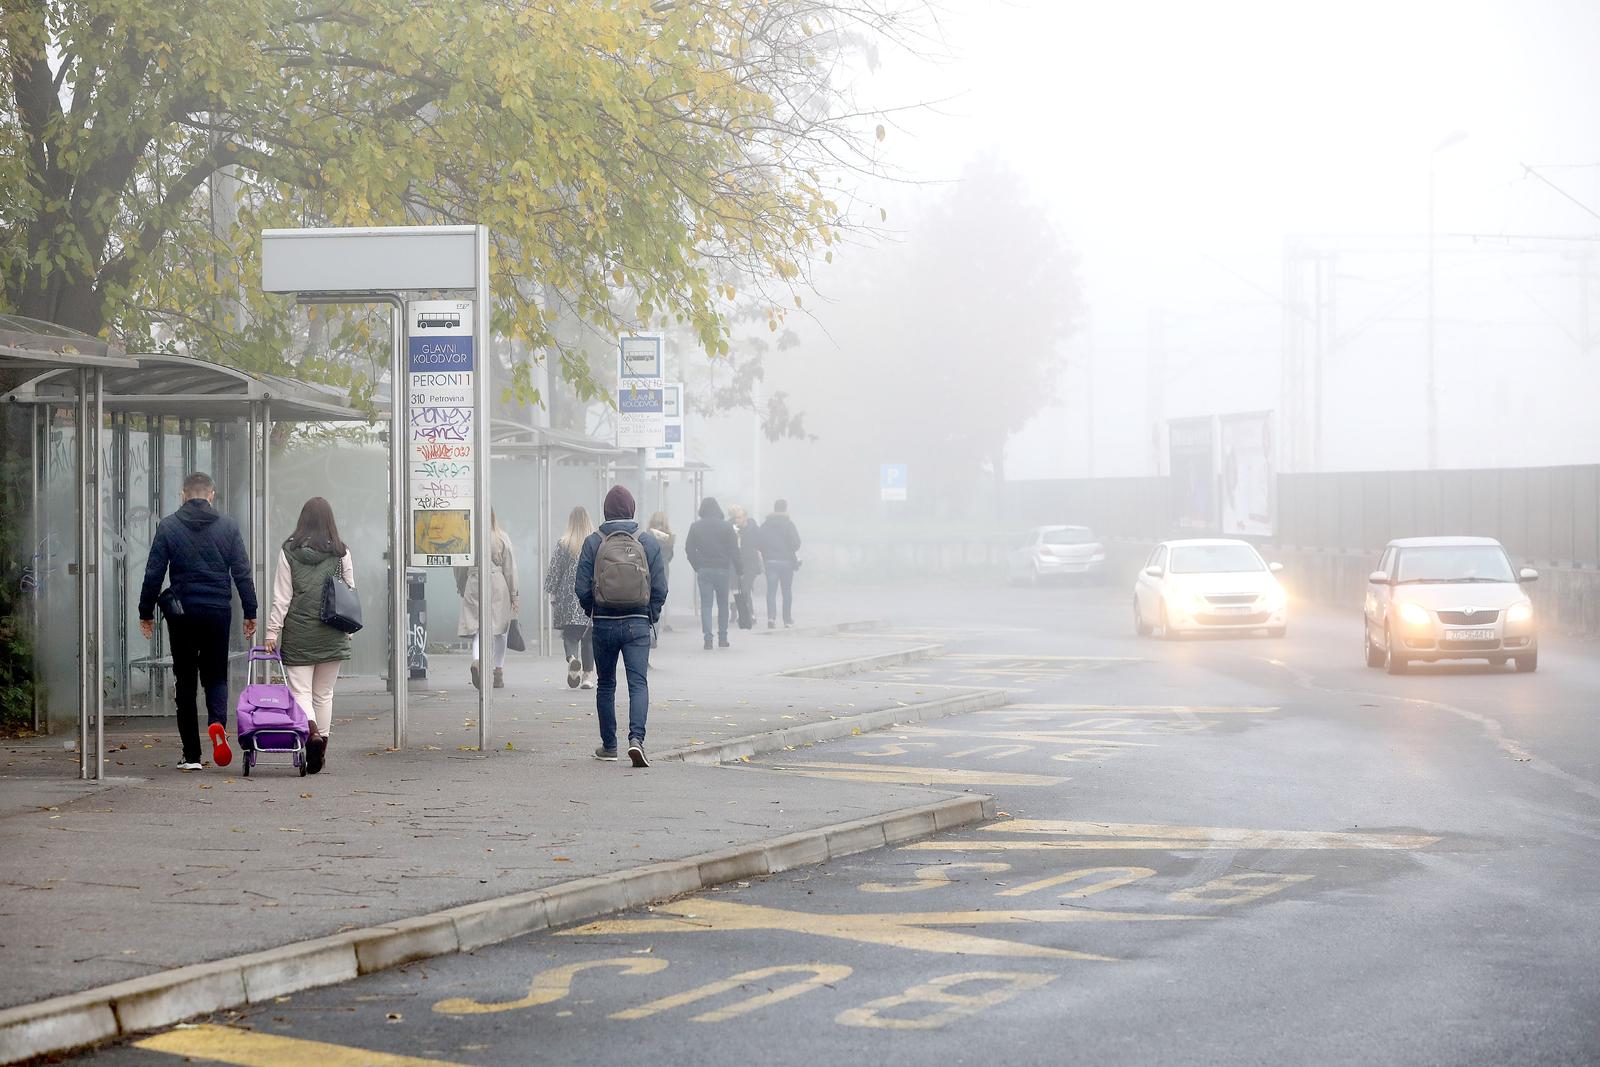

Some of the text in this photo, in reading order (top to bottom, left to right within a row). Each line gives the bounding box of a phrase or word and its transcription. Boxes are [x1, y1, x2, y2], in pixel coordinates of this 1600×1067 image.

[421, 344, 457, 354] GLAVNI
[413, 353, 467, 364] KOLODVOR
[410, 393, 465, 405] 310 Petrovina
[857, 861, 1317, 905] BUS
[431, 957, 1062, 1031] BUS
